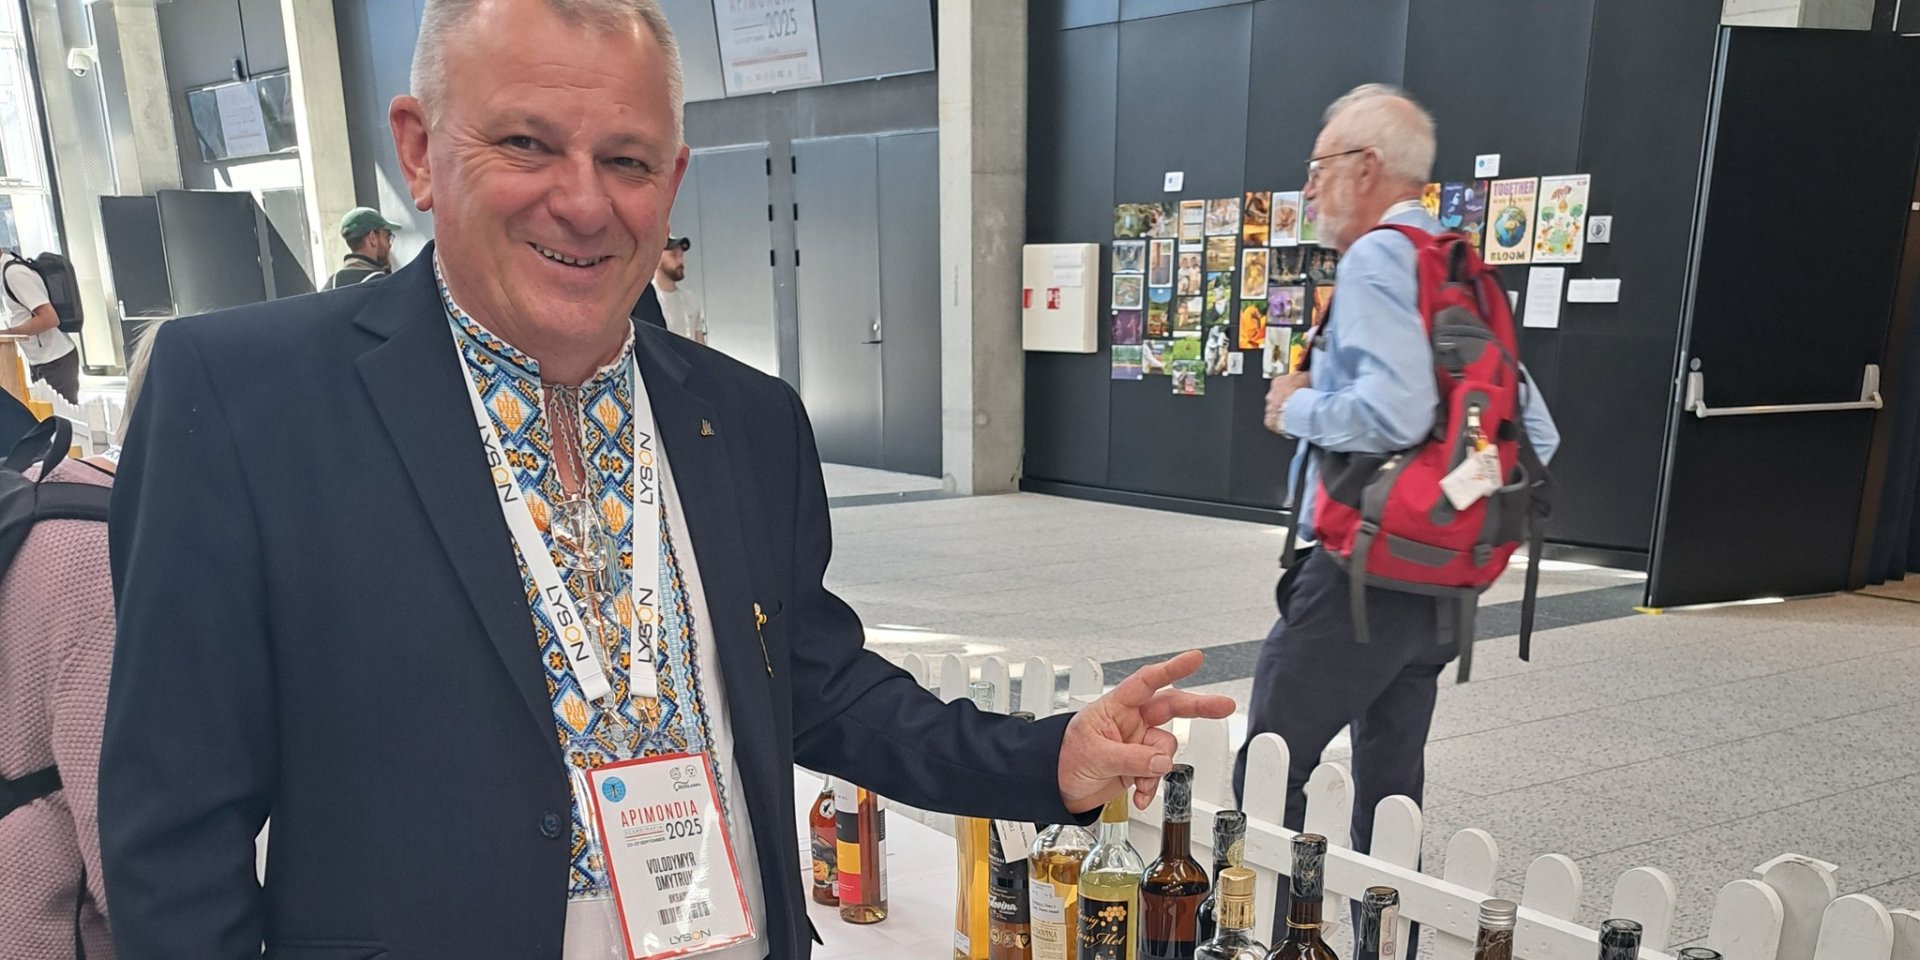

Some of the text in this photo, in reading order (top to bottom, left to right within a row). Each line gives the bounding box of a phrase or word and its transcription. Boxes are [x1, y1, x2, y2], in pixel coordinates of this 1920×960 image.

[765, 8, 798, 39] 2025
[1494, 181, 1535, 196] TOGETHER
[1490, 251, 1525, 261] BLOOM
[639, 432, 654, 505] LYSON
[546, 585, 589, 661] LYSON
[638, 588, 653, 664] LYSON
[621, 800, 698, 828] APIMONDIA
[666, 818, 703, 840] 2025
[646, 852, 697, 875] VOLODYMYR
[669, 928, 712, 945] LYSON
